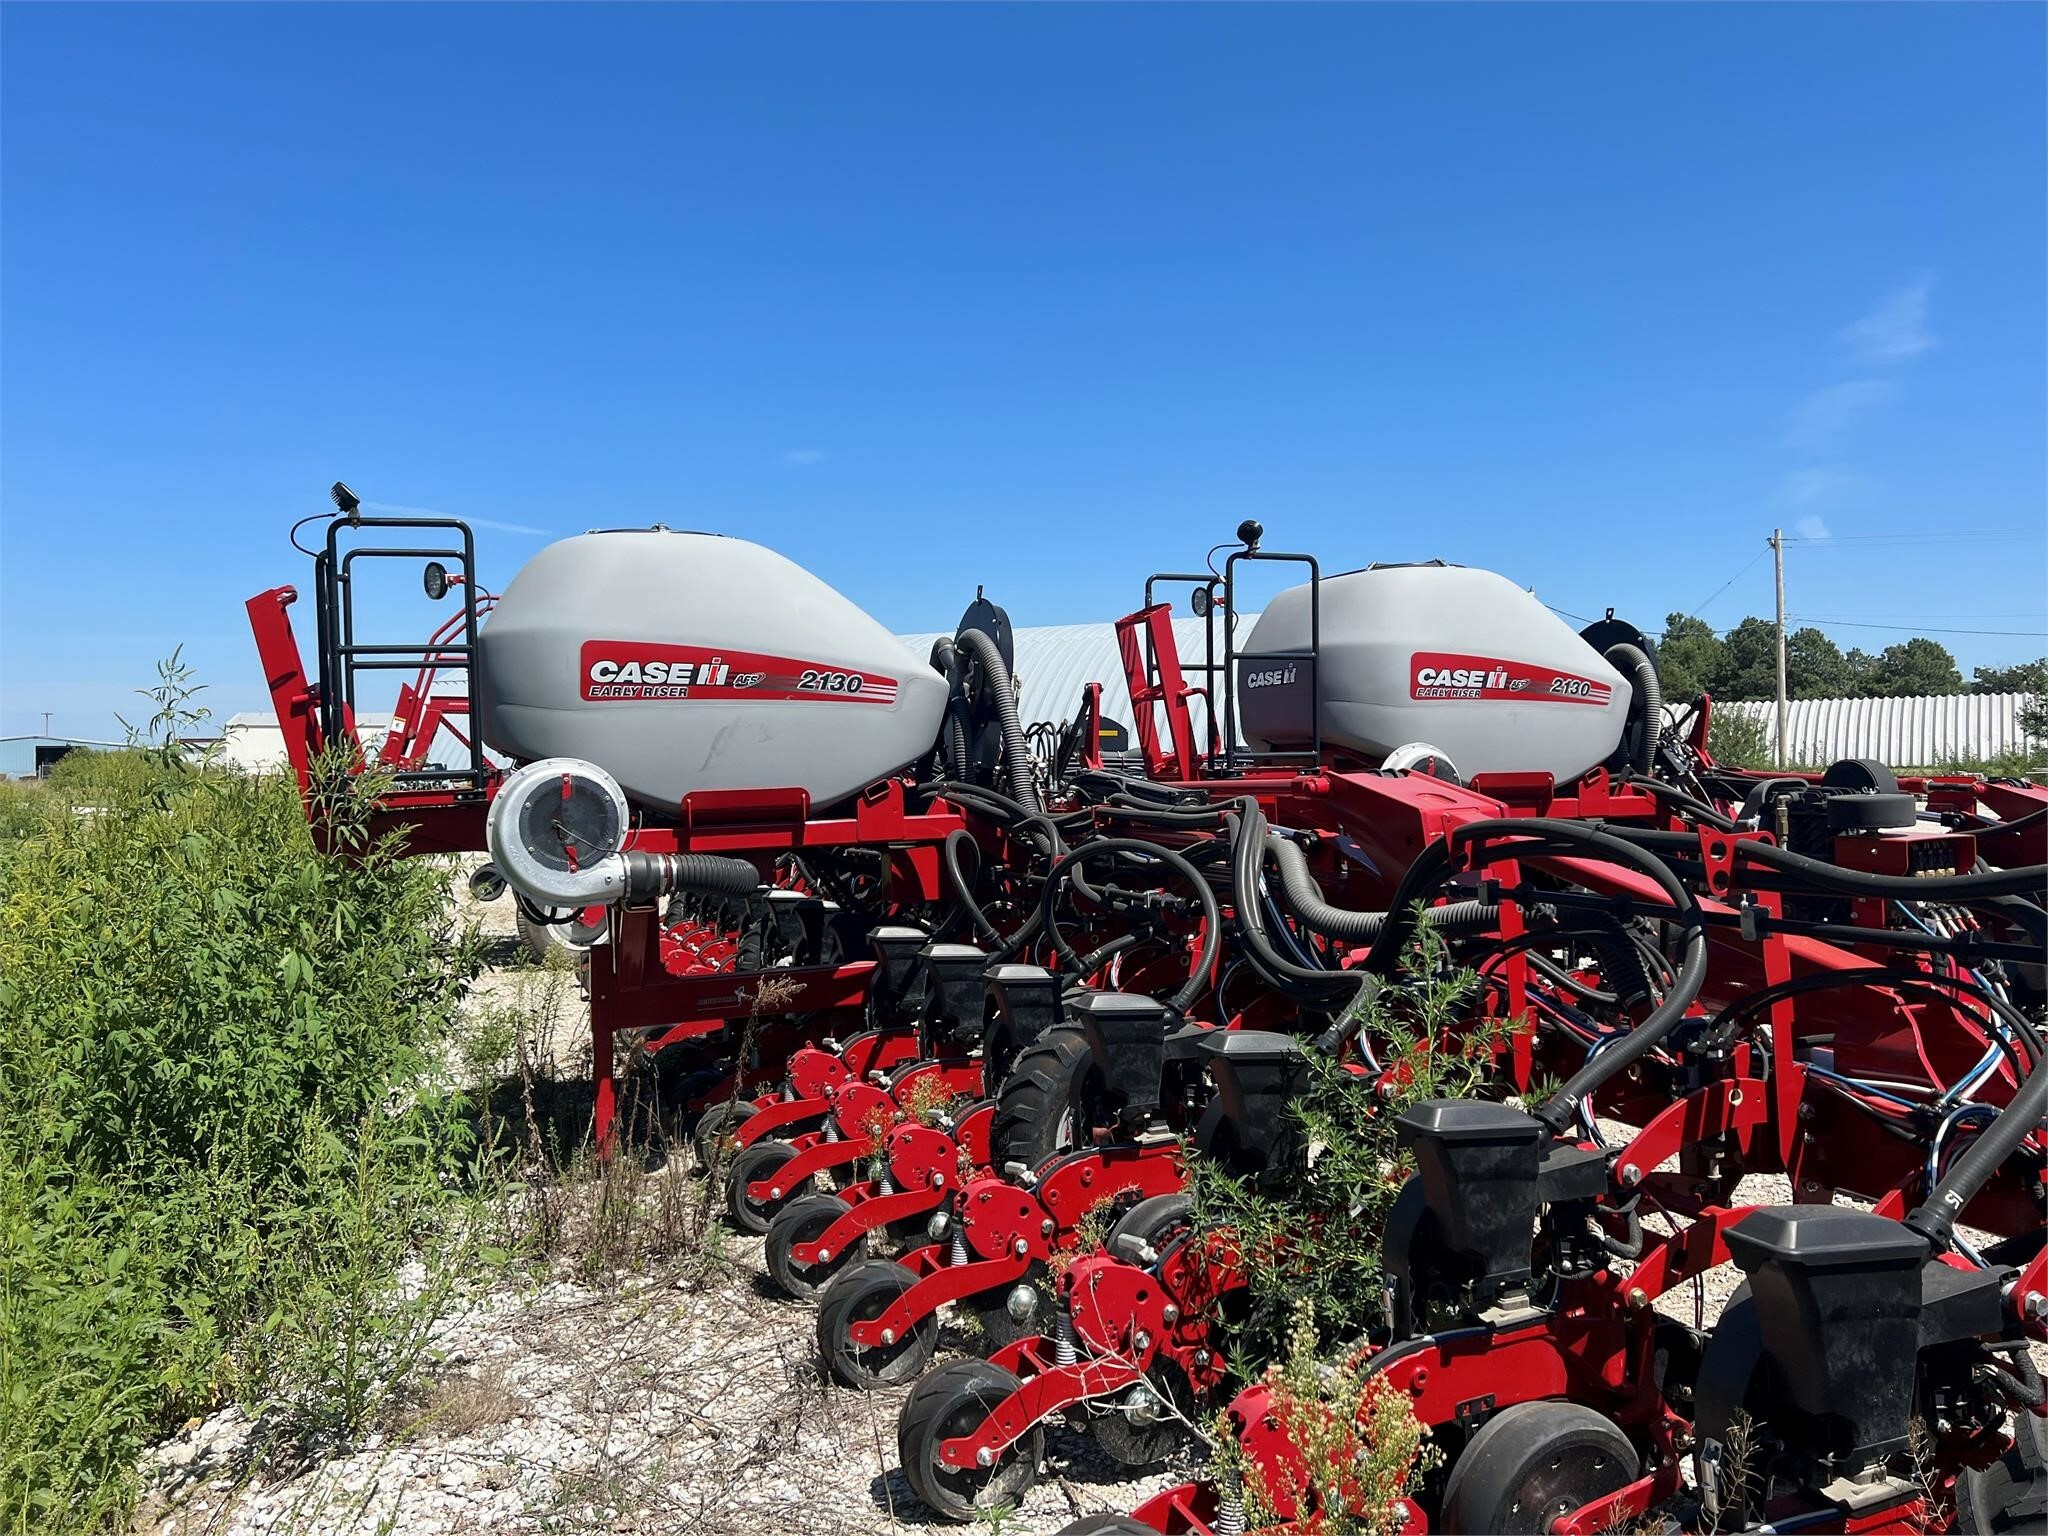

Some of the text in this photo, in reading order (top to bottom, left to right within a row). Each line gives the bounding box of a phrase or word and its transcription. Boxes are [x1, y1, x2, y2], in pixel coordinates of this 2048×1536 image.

[590, 660, 694, 684] CASE
[733, 673, 761, 687] AFS
[797, 670, 864, 693] 2130
[1248, 670, 1282, 688] CASE
[1417, 668, 1485, 688] CASE
[1550, 677, 1591, 696] 2130
[589, 685, 688, 698] EARLY RISER
[1416, 688, 1481, 698] EARLY RISER
[1944, 1189, 1964, 1211] 15
